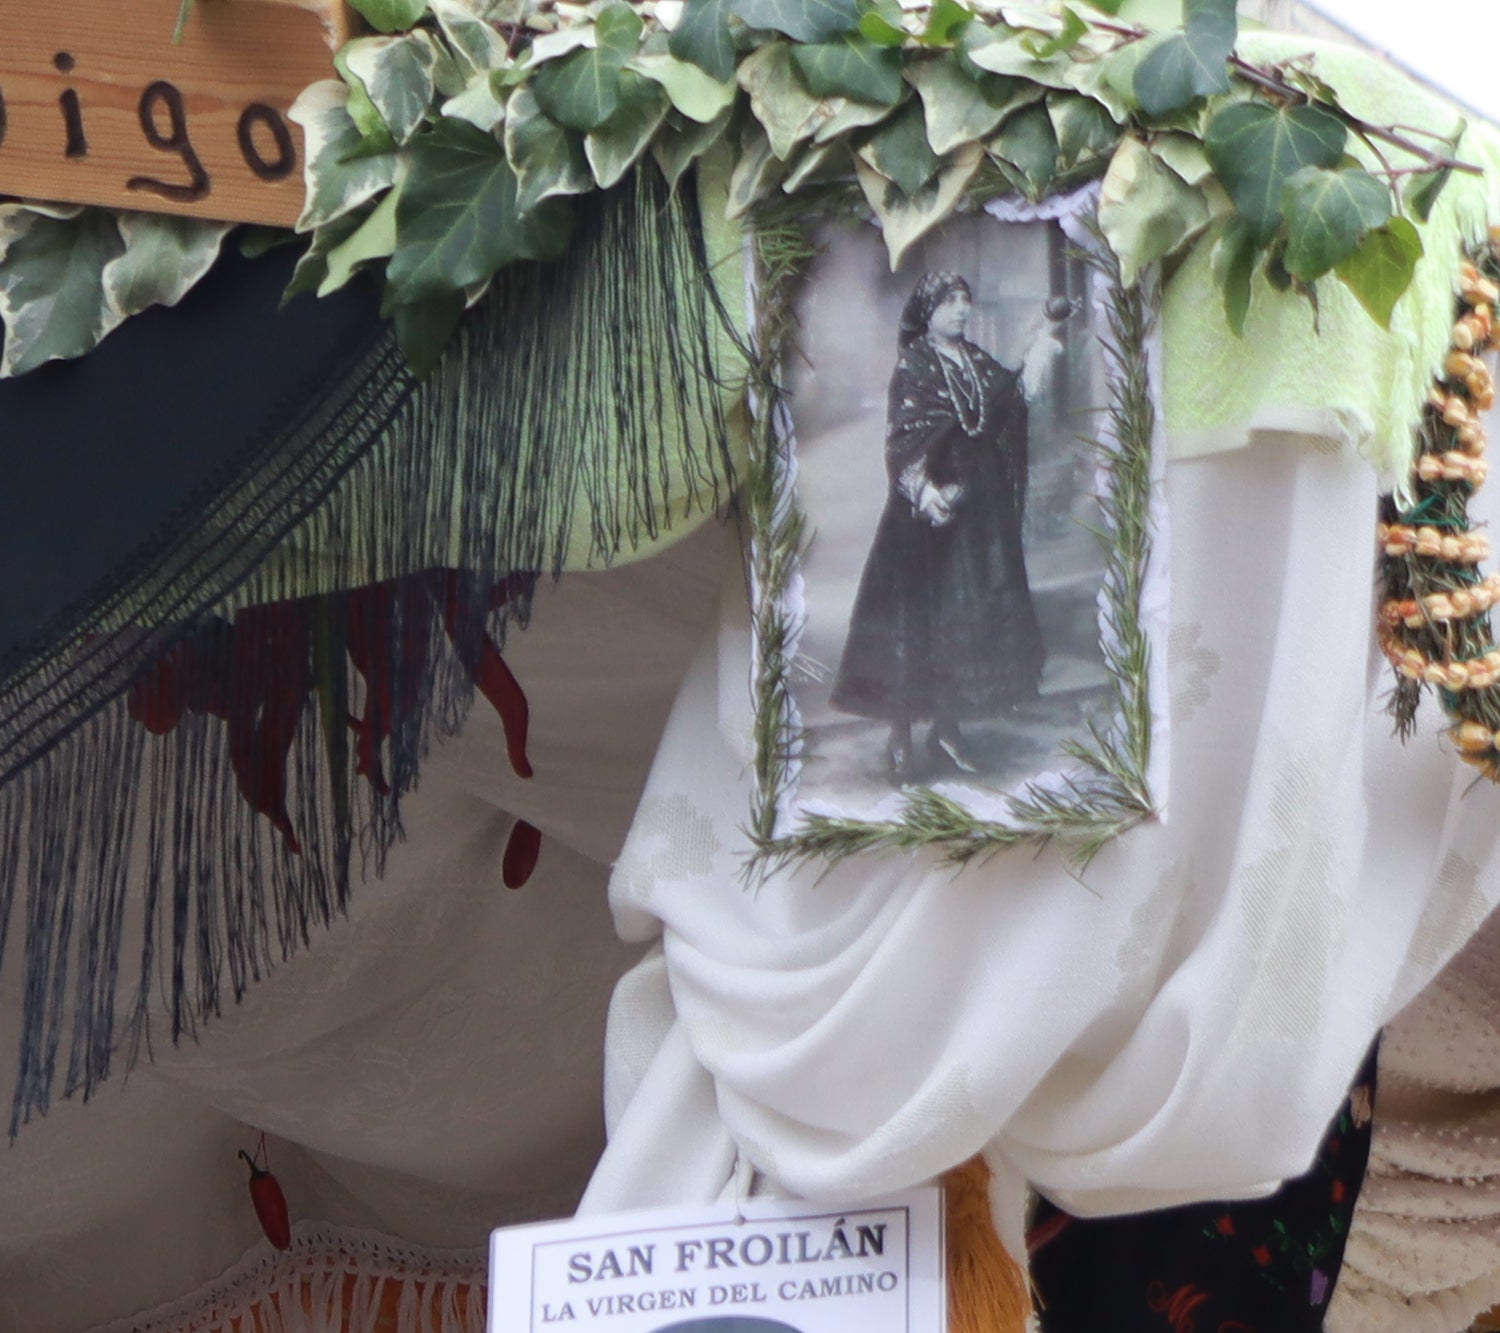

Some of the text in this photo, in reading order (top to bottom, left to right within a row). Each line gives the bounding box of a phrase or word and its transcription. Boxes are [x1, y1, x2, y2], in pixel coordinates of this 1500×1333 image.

[567, 1218, 887, 1284] SAN FROILÁN
[541, 1271, 898, 1323] LA VIRGEN DEL CAMINO
